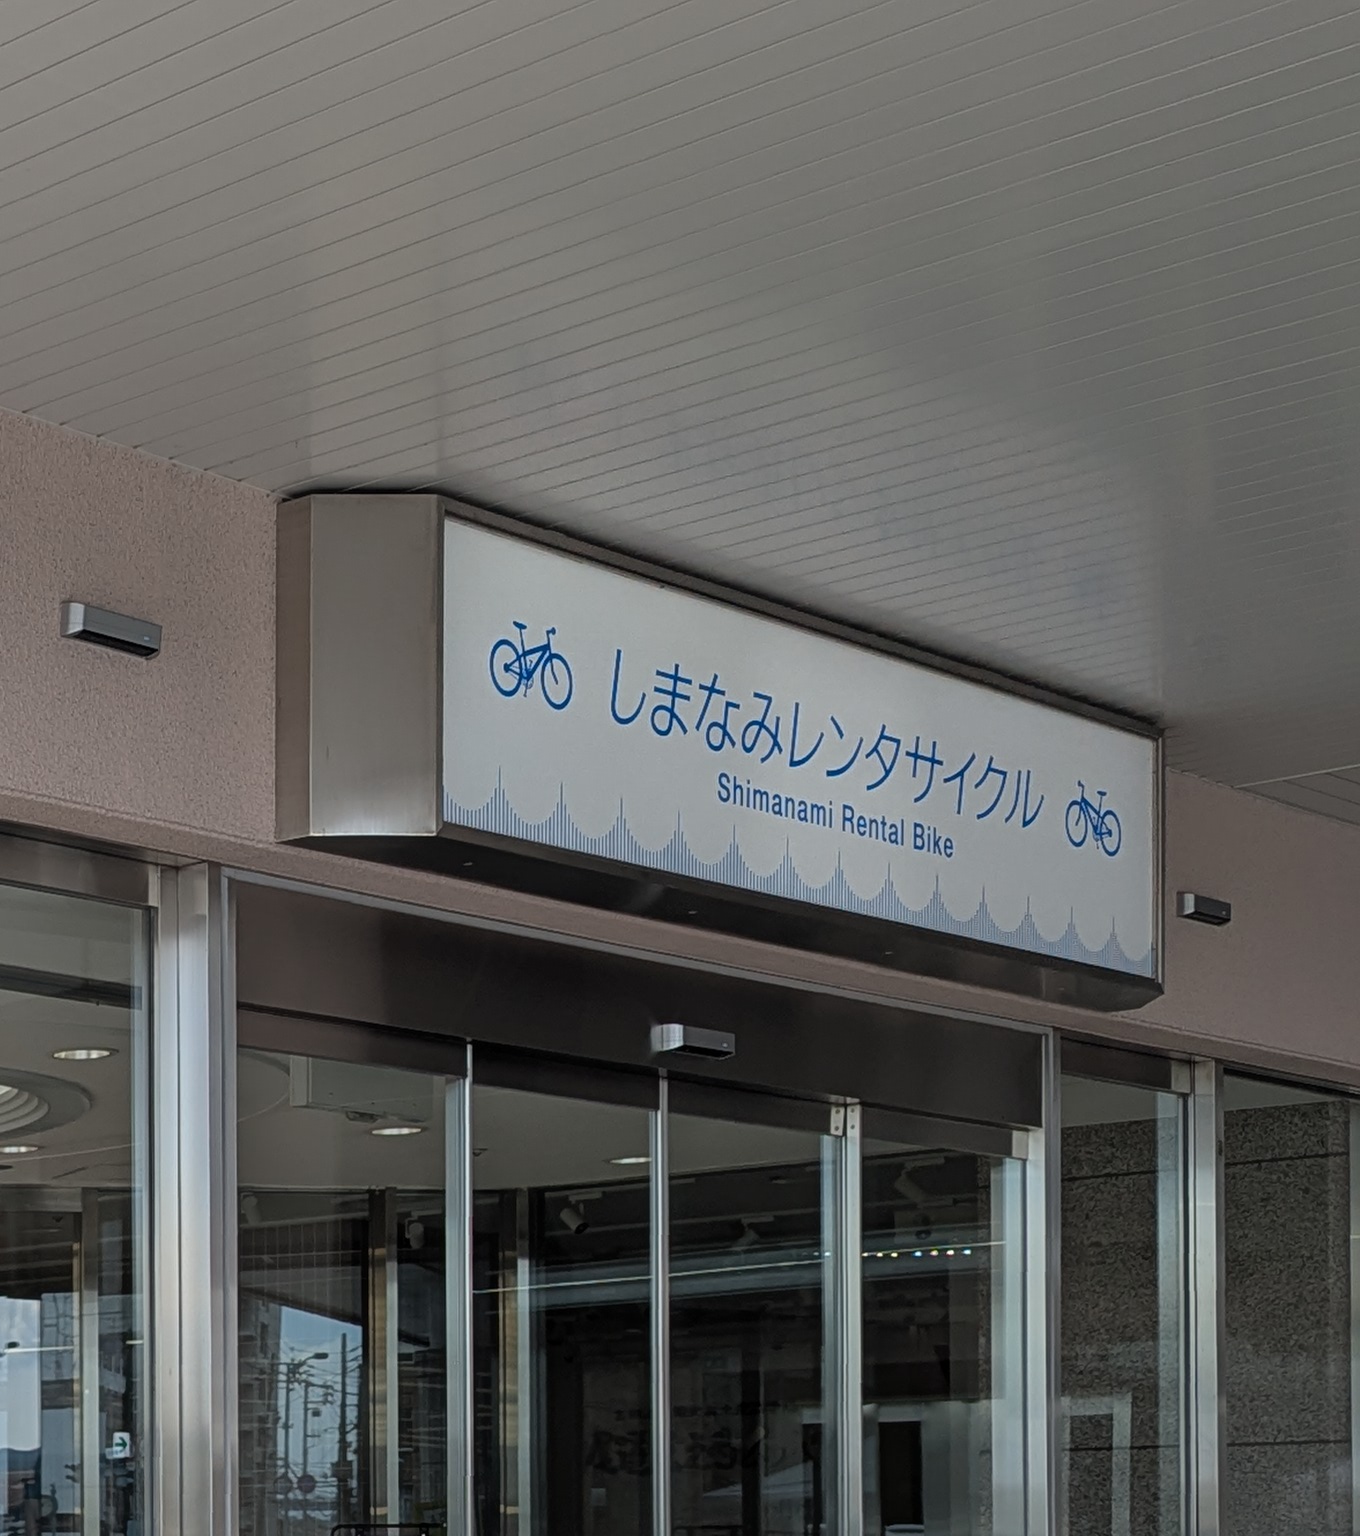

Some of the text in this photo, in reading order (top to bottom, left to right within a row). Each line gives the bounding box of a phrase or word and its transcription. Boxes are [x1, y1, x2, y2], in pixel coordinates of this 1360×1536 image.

[609, 648, 1045, 828] しまなみレンタサイクル
[717, 772, 955, 859] Shimanami Rental Bike
